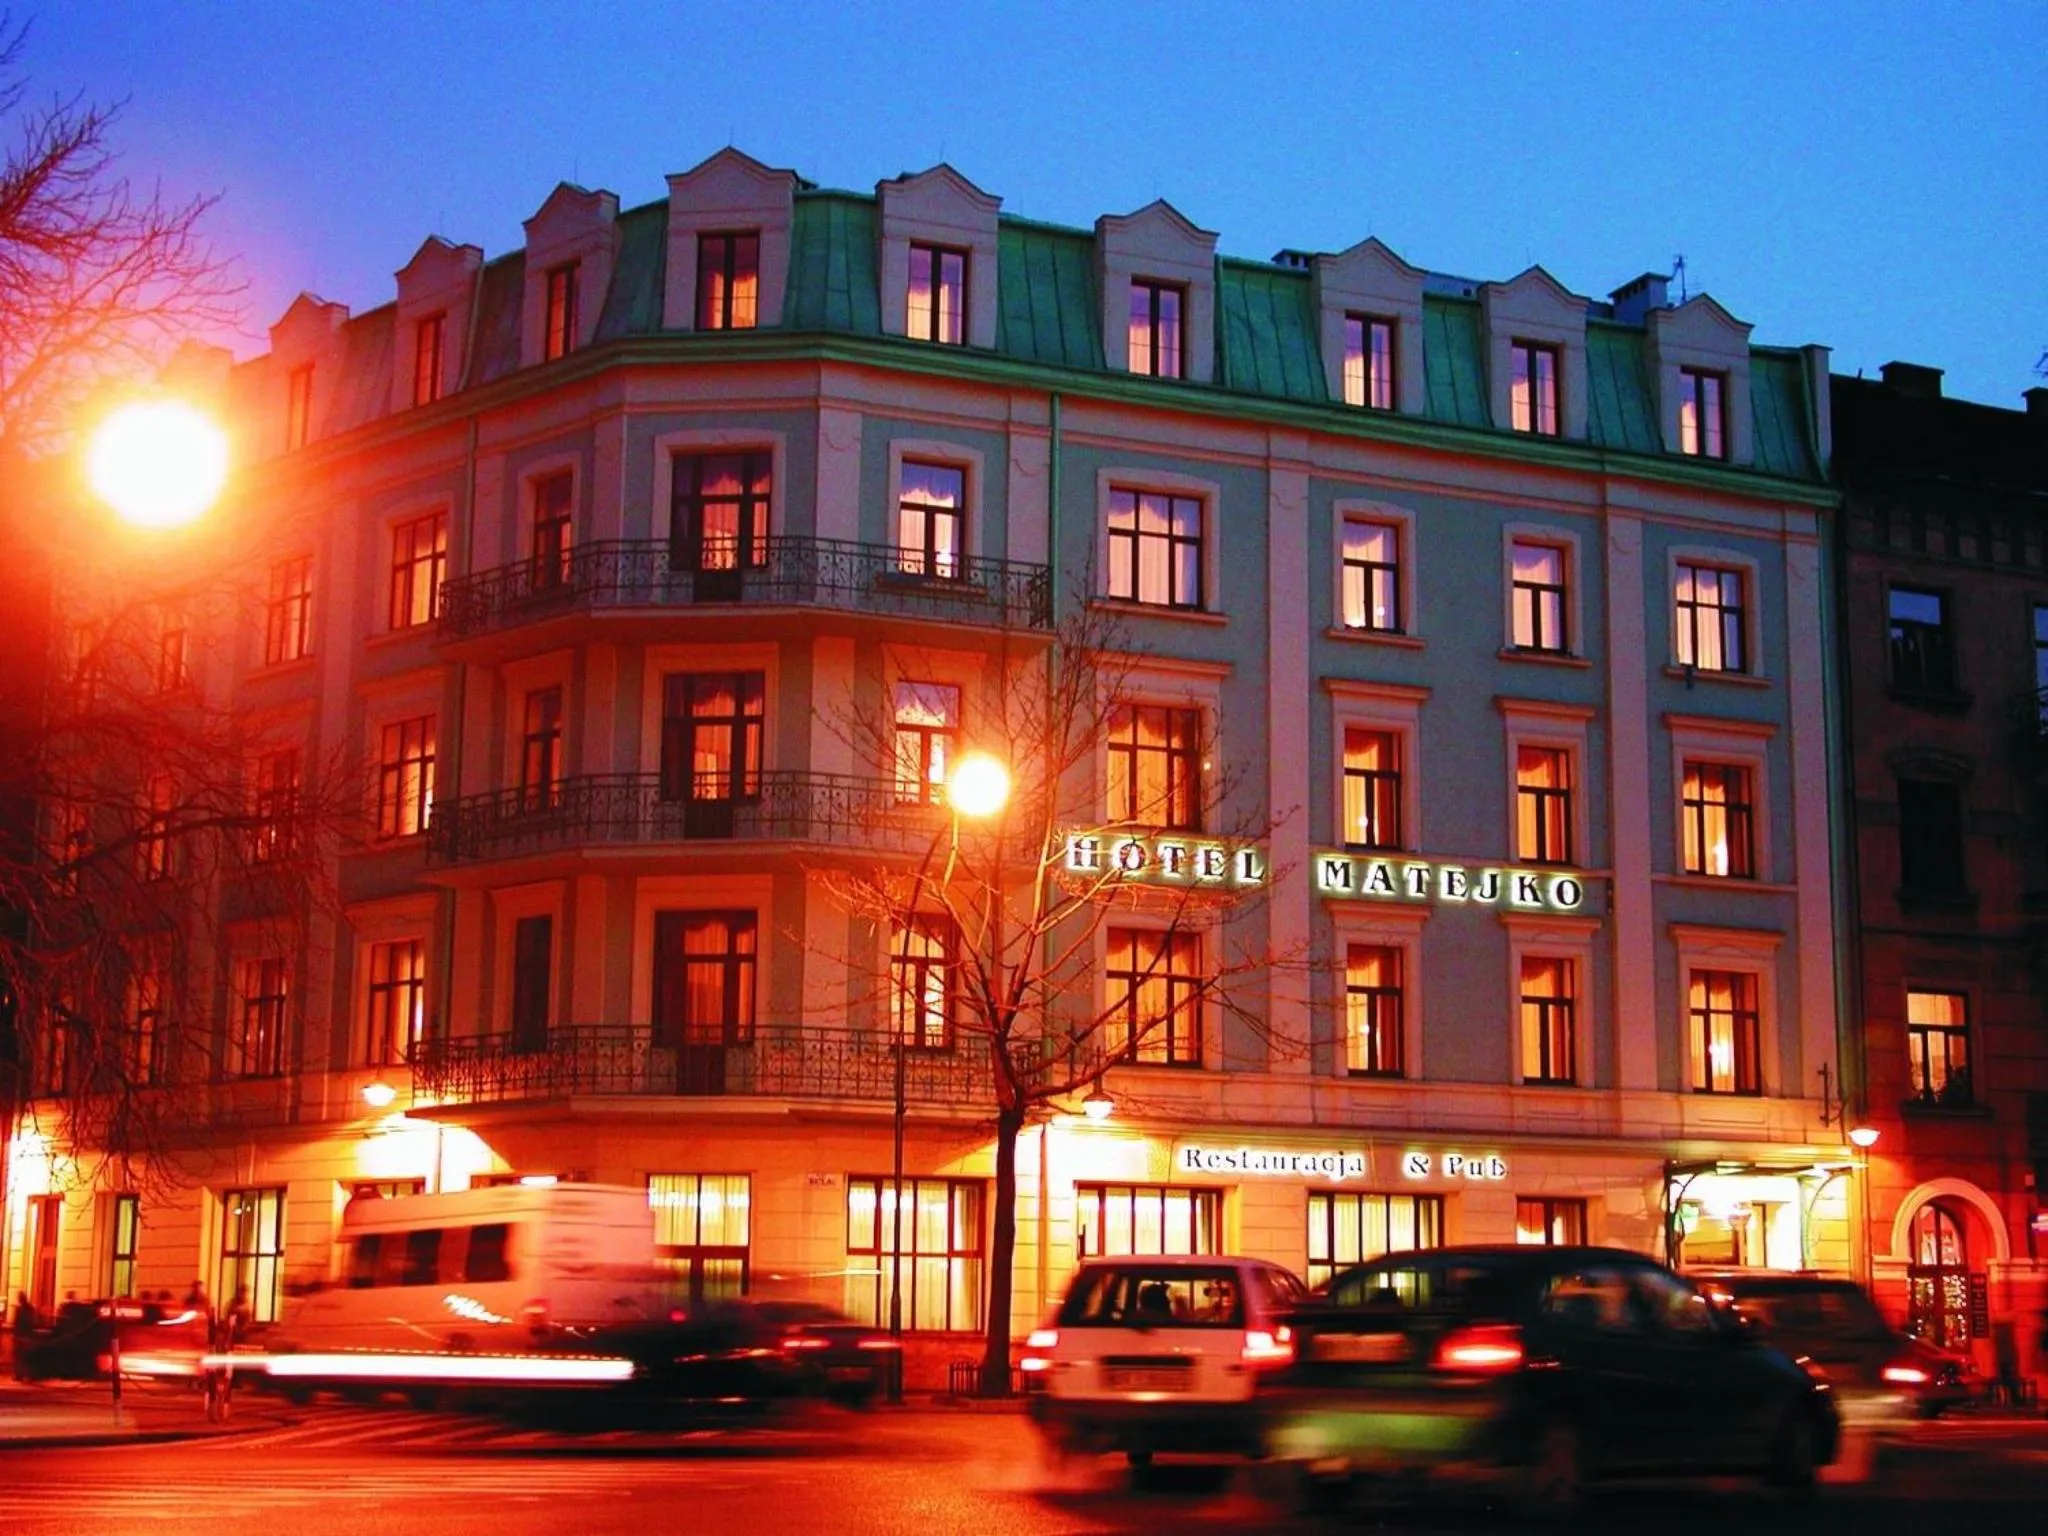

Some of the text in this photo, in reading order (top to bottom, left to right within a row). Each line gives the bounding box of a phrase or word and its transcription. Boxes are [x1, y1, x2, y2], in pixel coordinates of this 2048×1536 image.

[1070, 837, 1582, 907] HOTEL MATEJKO
[1185, 1148, 1507, 1177] Restauracja & Pub
